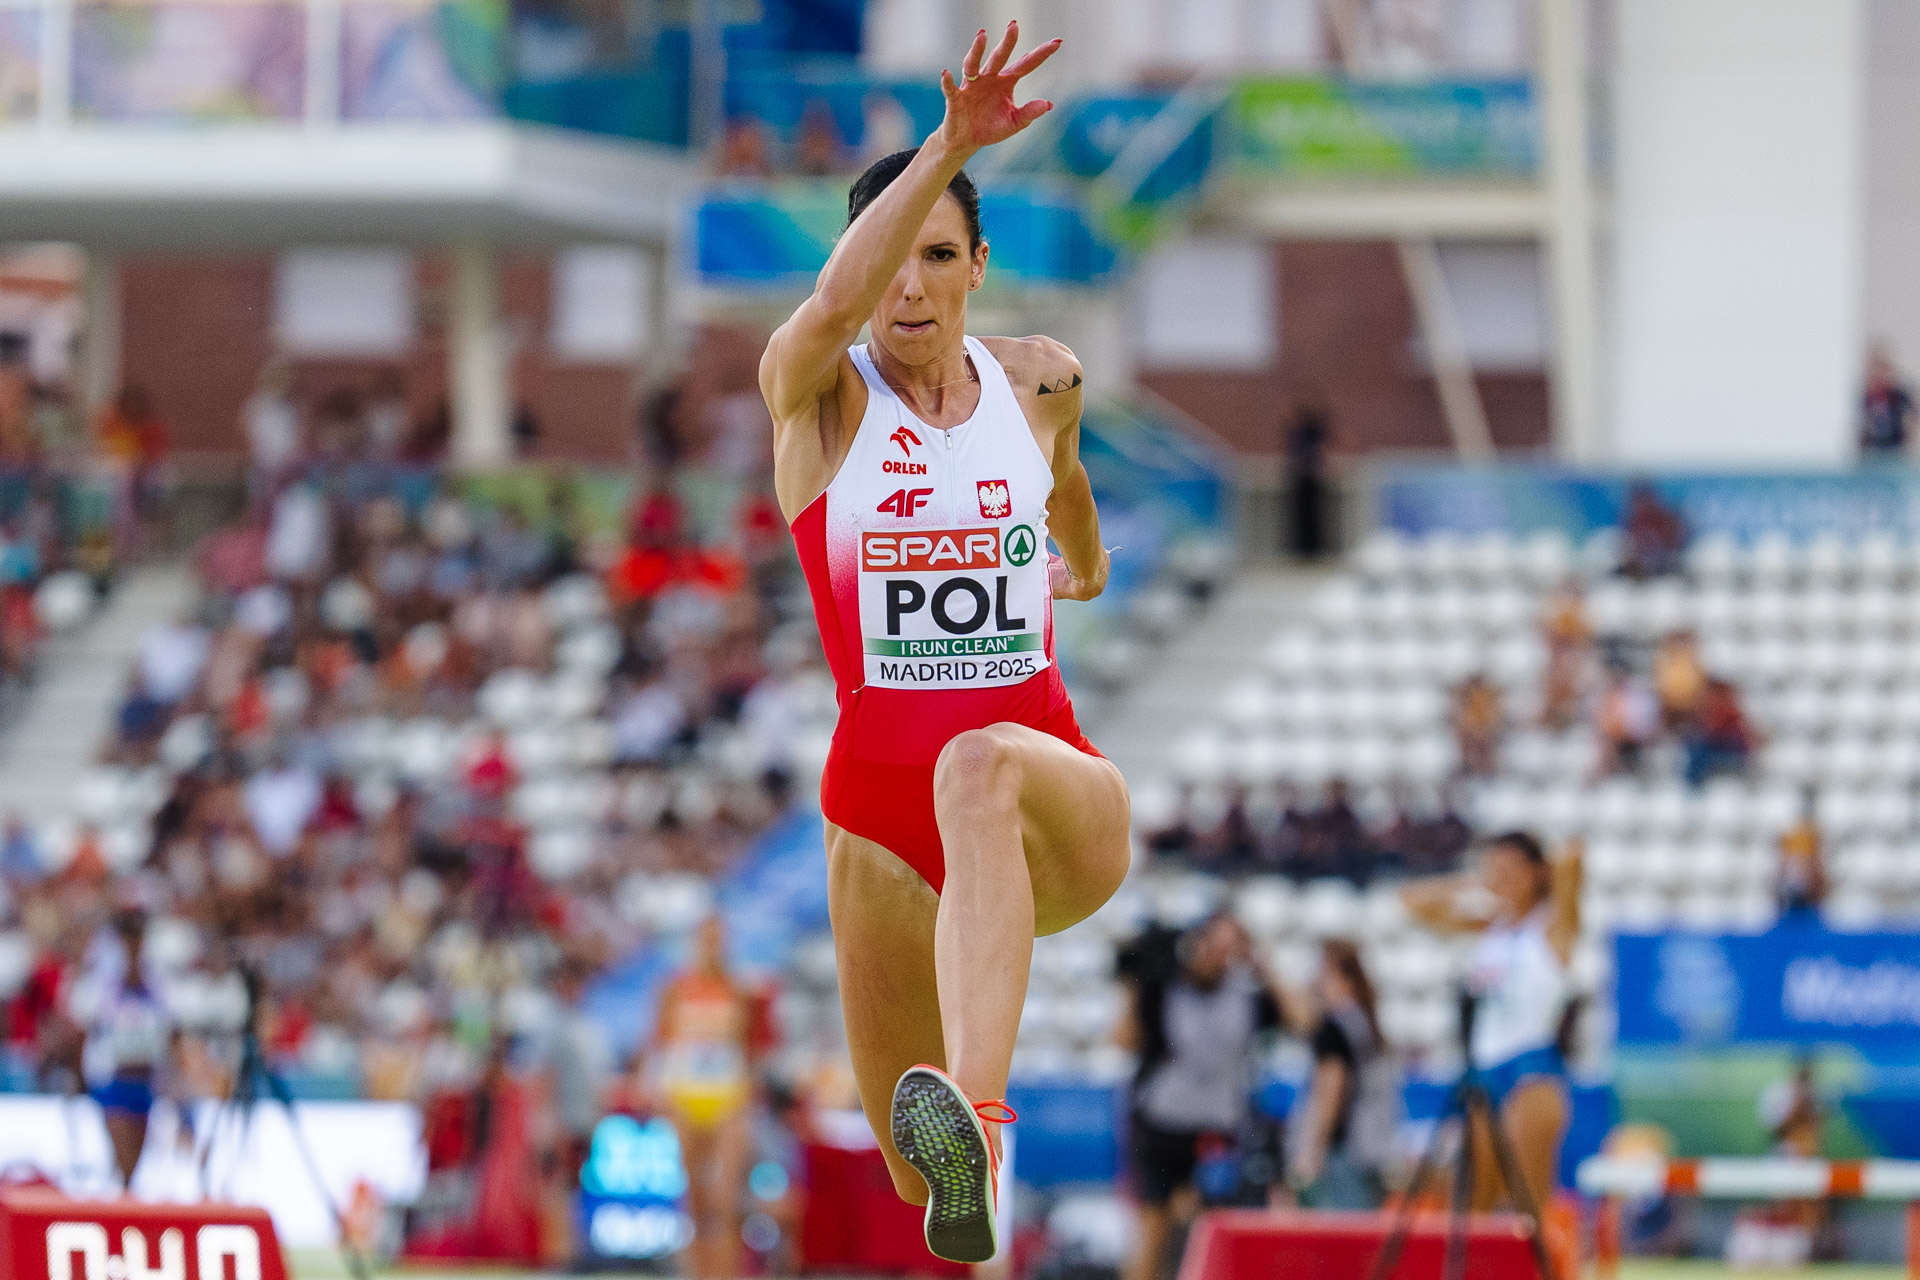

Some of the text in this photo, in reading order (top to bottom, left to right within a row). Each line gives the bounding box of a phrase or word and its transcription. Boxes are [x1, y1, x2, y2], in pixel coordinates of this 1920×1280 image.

[882, 460, 927, 475] ORLEN
[877, 487, 934, 517] 4F
[865, 535, 997, 566] SPAR
[886, 576, 1025, 635] POL
[901, 642, 906, 655] I
[909, 640, 947, 655] RUN
[880, 658, 1036, 681] MADRID 2025
